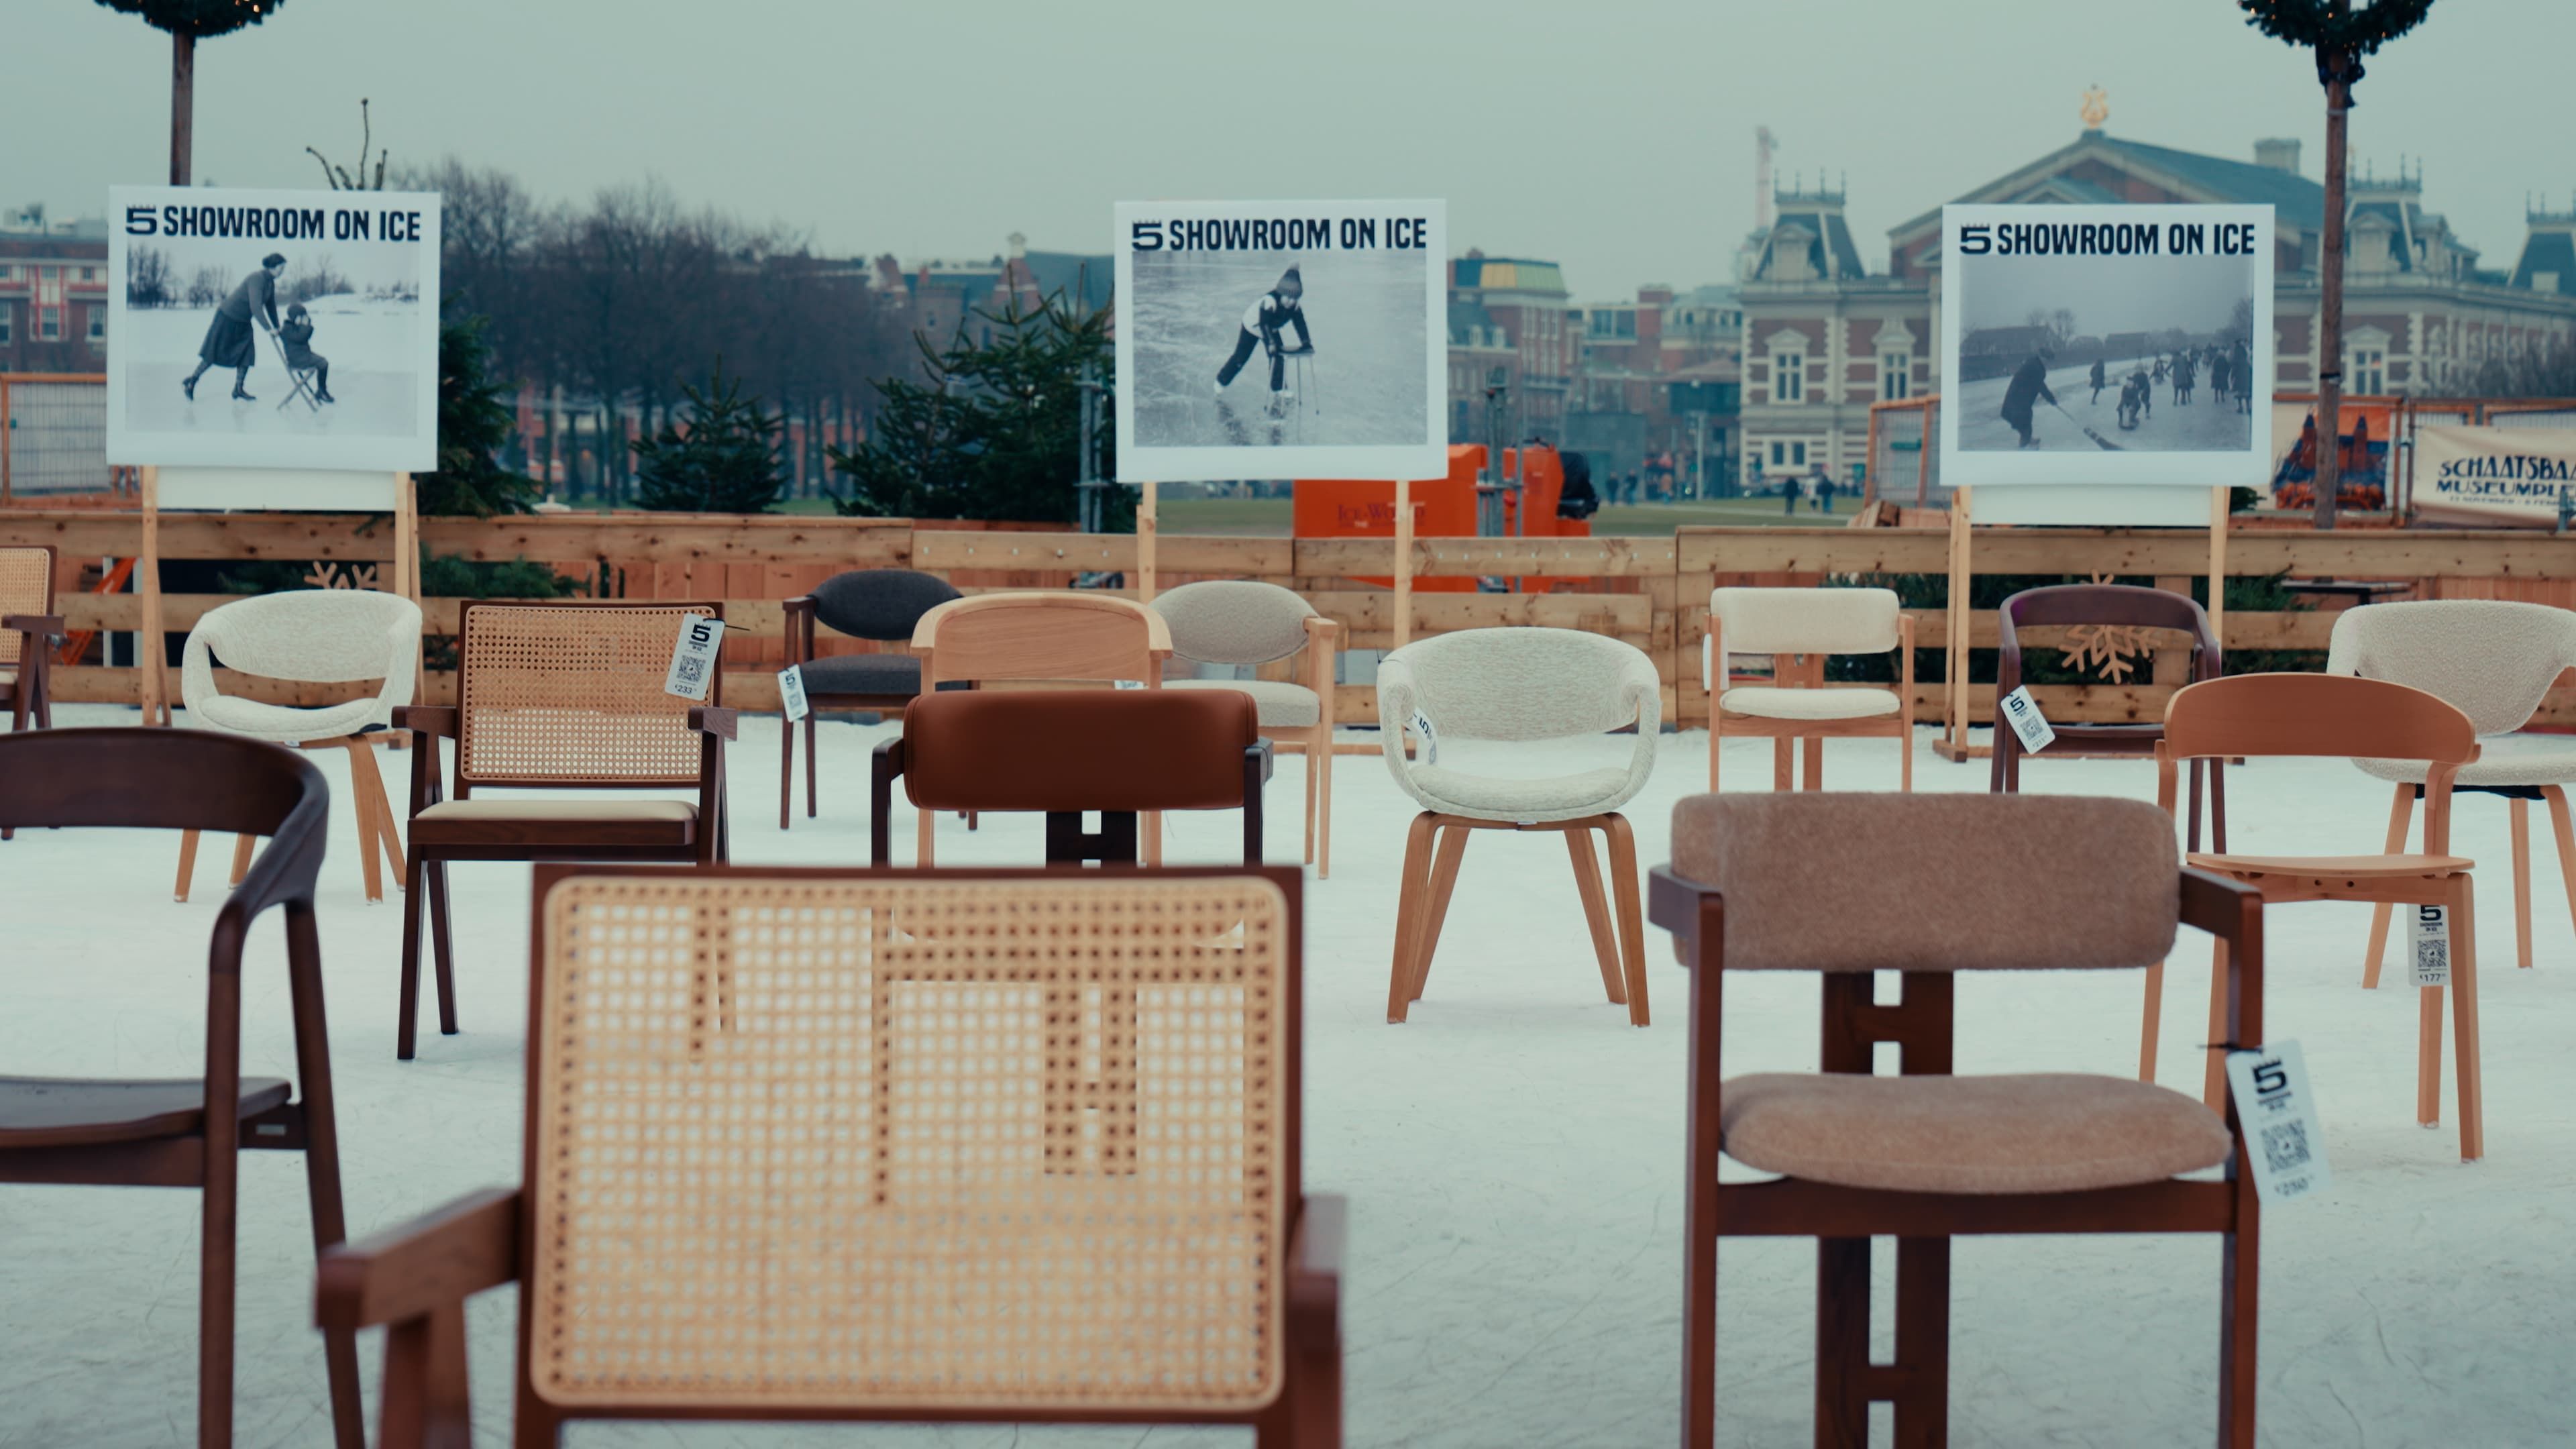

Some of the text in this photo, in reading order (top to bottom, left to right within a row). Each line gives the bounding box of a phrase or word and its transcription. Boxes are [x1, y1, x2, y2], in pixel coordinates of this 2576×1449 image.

[126, 204, 421, 241] 5 SHOWROOM ON ICE
[1132, 218, 1426, 251] 5 SHOWROOM ON ICE
[1960, 223, 2255, 255] 5 SHOWROOM ON ICE
[690, 622, 712, 643] 5
[2010, 696, 2025, 712] 5
[2420, 904, 2442, 921] 5
[2253, 1059, 2288, 1095] 5
